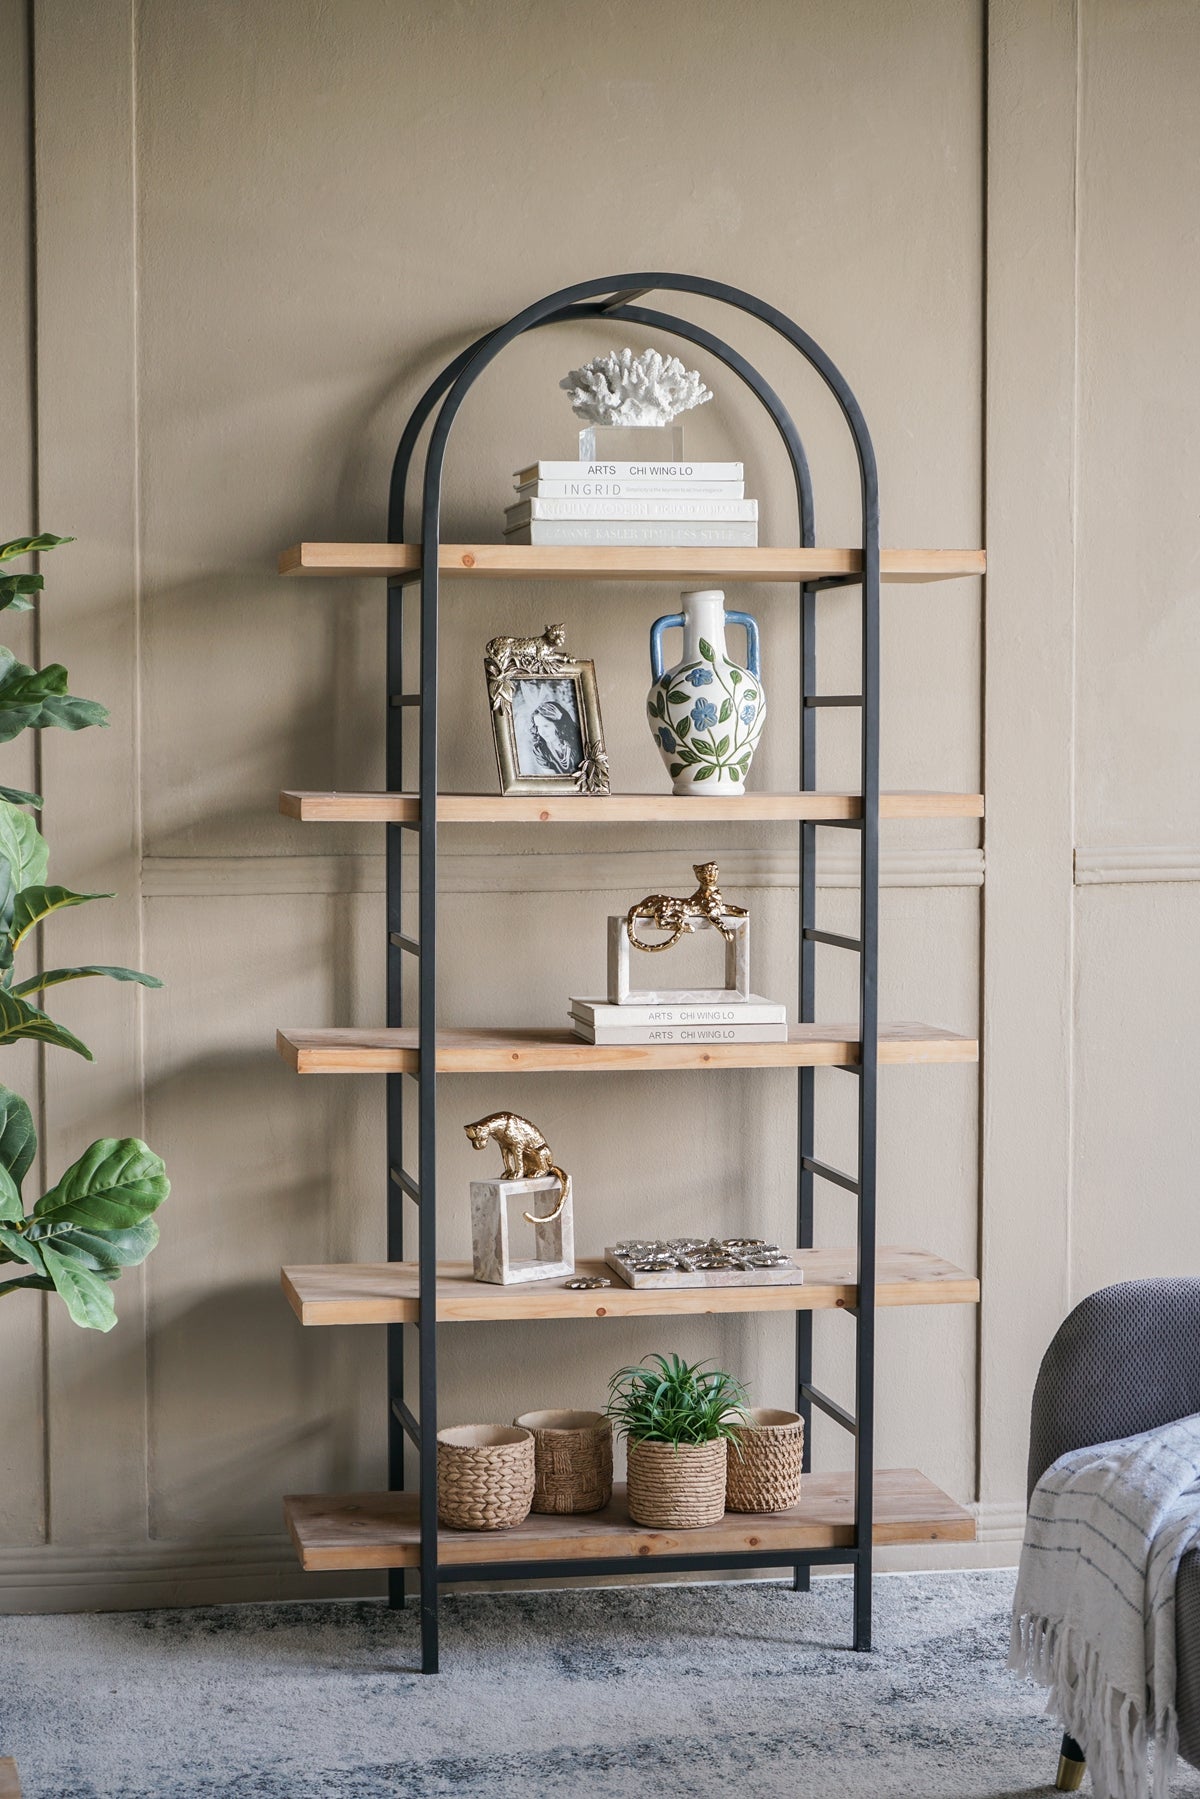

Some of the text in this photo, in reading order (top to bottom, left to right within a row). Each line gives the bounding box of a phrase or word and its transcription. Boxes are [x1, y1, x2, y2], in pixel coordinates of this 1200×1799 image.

[588, 465, 693, 476] ARTS CHI WING LO
[564, 483, 621, 496] INGRID
[648, 1011, 735, 1020] ARTS CHI WING LO
[648, 1030, 735, 1040] ARTS CHI WING LO
